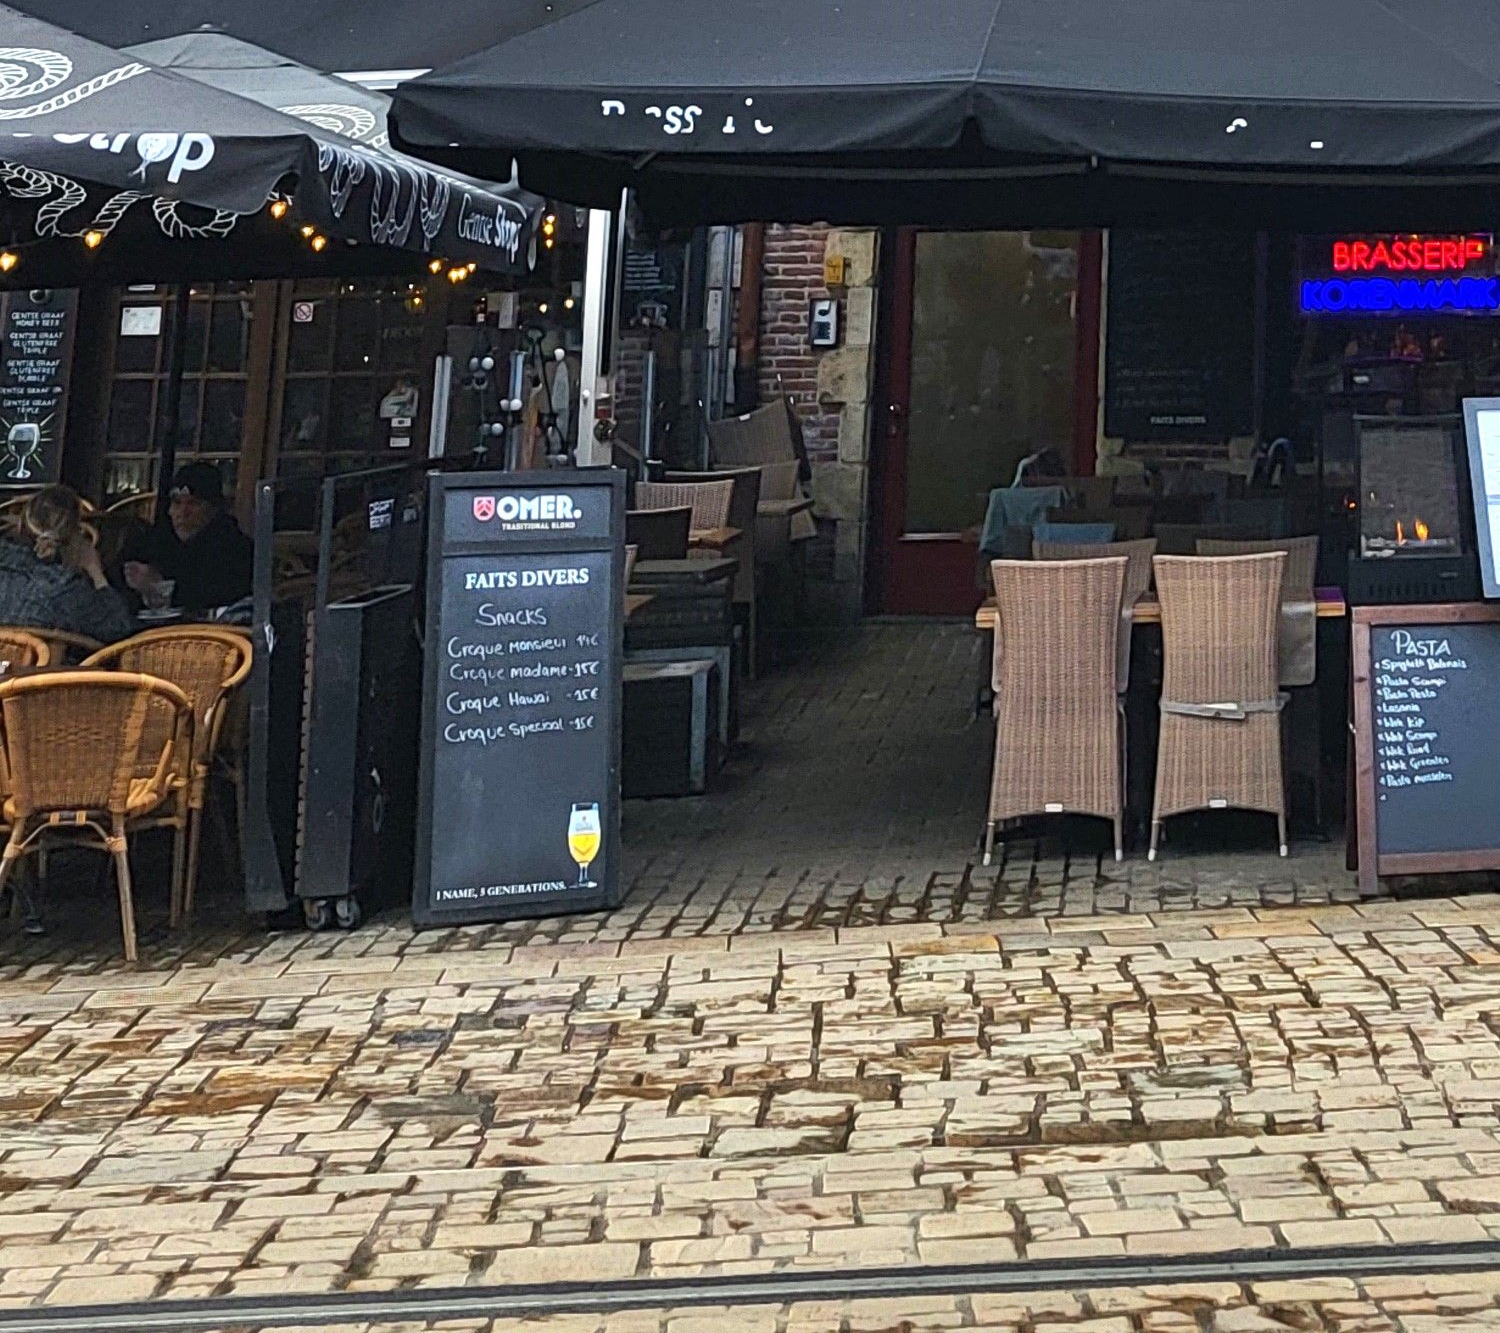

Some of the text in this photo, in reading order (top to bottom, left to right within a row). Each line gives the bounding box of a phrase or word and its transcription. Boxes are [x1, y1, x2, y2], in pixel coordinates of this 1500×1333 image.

[497, 495, 582, 521] OMER.
[502, 522, 549, 531] TRADITIONAL
[465, 568, 589, 590] FAITS DIVERS
[448, 636, 505, 661] Croque
[450, 663, 505, 687] Croque
[446, 692, 501, 715] Croque
[444, 723, 506, 746] Croque
[442, 888, 478, 900] NAME,
[487, 881, 567, 896] GENERATIONS.
